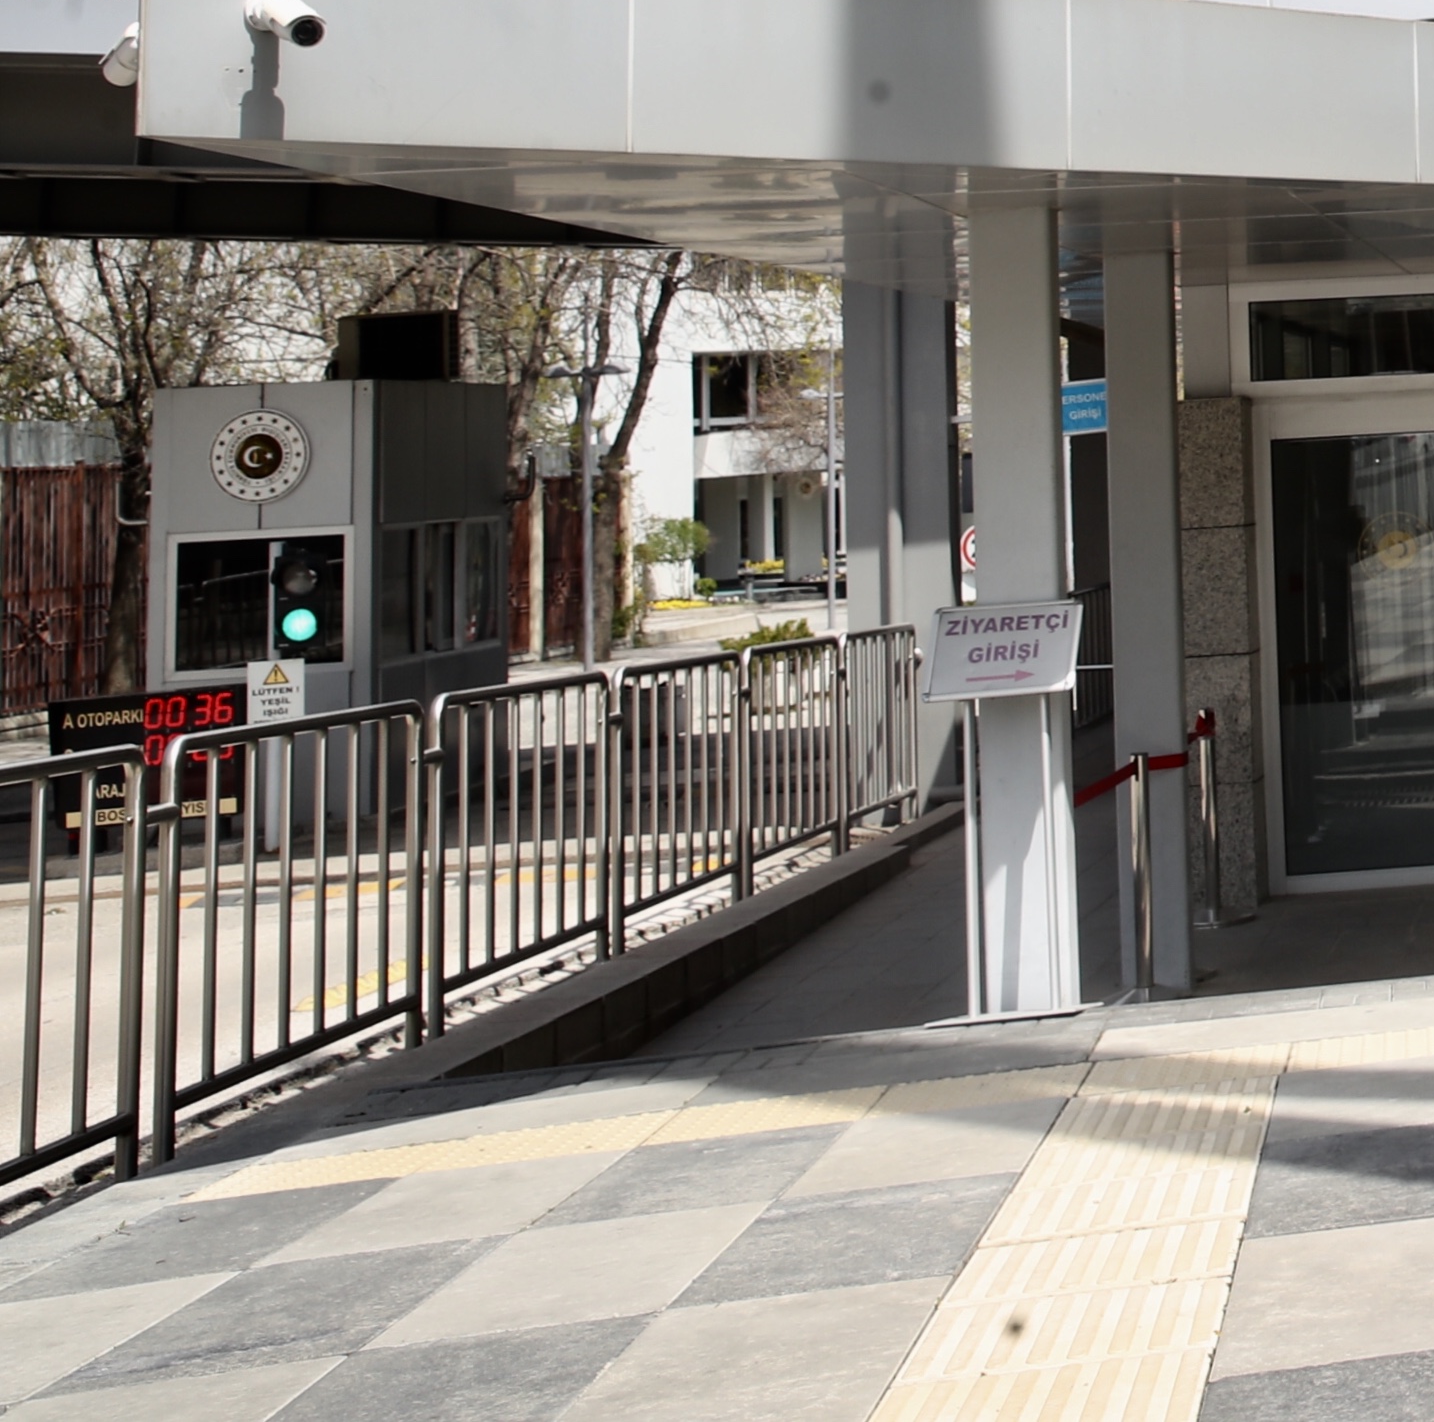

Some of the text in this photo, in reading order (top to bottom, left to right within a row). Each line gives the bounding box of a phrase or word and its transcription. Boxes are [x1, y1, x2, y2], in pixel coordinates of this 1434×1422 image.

[1062, 392, 1106, 404] ERSONE
[1069, 406, 1101, 419] GİRİŞİ
[945, 610, 1068, 636] ZİYARETÇİ
[968, 639, 1039, 663] GİRİŞİ
[252, 686, 293, 696] LÜTFEN
[261, 696, 291, 706] YEŞİL
[63, 709, 144, 729] A OTOPARKI
